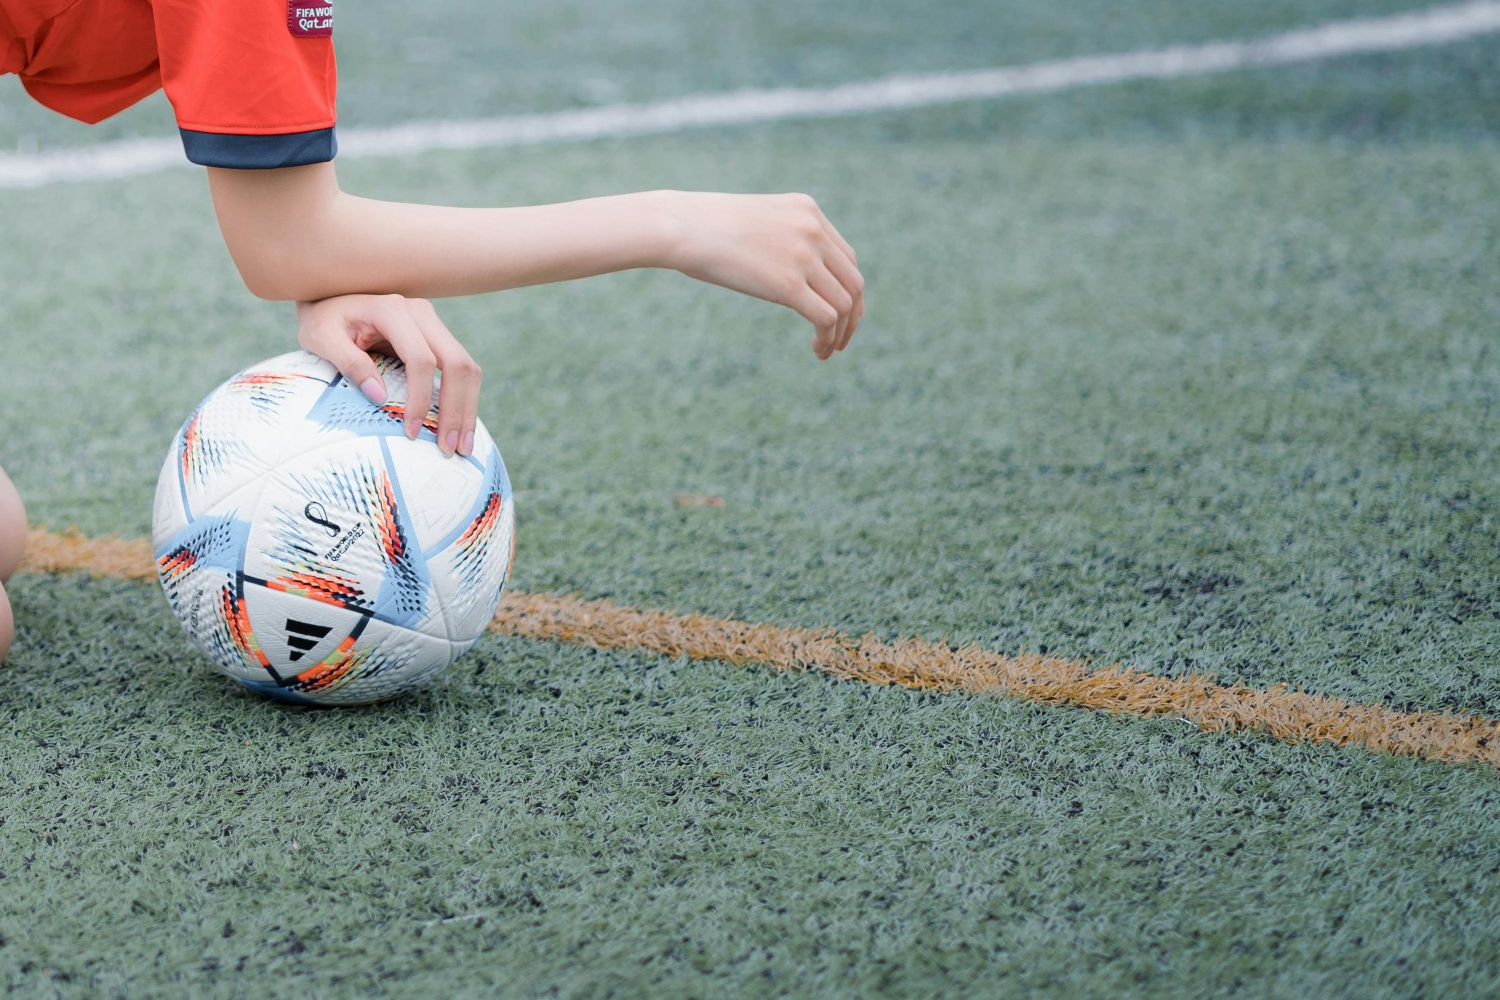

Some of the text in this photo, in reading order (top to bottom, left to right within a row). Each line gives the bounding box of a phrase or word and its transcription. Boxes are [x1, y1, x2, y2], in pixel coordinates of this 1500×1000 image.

[296, 8, 315, 18] FIFA
[324, 522, 362, 560] FIFA WORLD CUP
